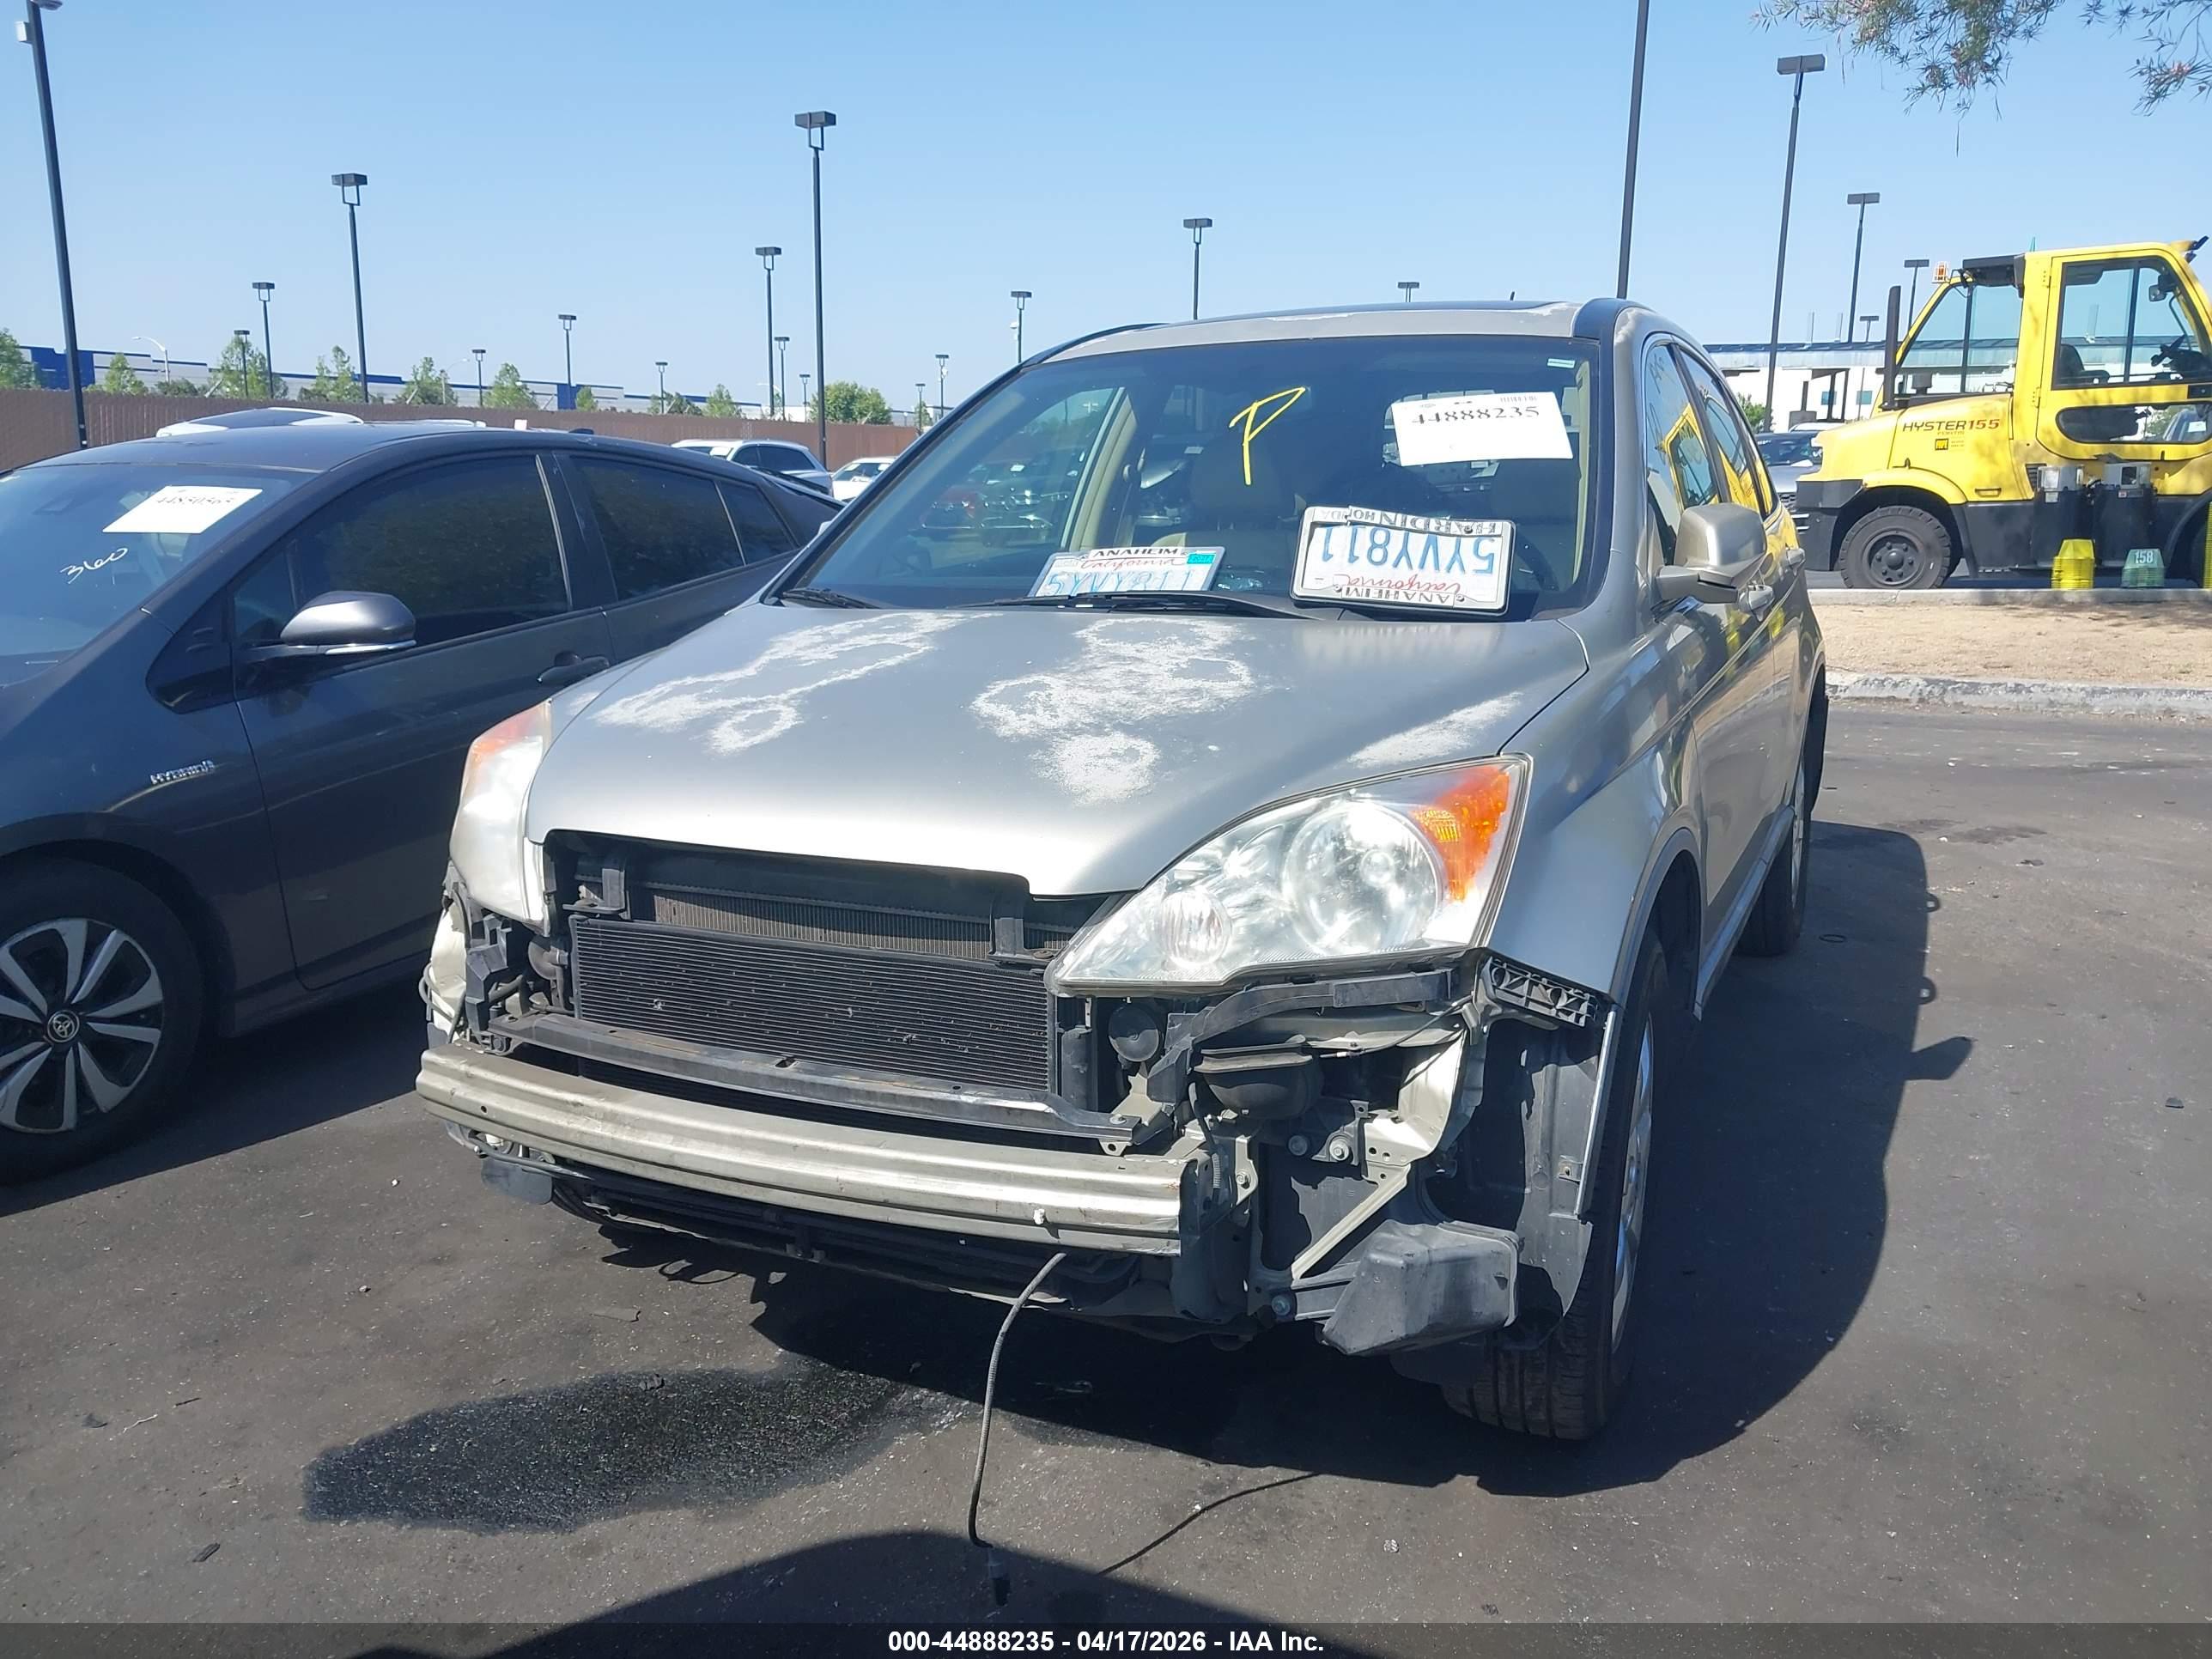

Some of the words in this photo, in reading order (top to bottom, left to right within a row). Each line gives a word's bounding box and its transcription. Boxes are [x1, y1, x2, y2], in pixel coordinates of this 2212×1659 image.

[1412, 405, 1540, 425] 44888235
[1228, 386, 1306, 485] P
[1095, 548, 1179, 556] ANAHEIM
[1322, 526, 1496, 574] 5YVY811
[2135, 550, 2154, 563] 158
[1080, 558, 1184, 571] California
[1047, 570, 1193, 595] 5YVY811
[1333, 573, 1461, 592] California
[1346, 586, 1450, 605] ANAHEIM
